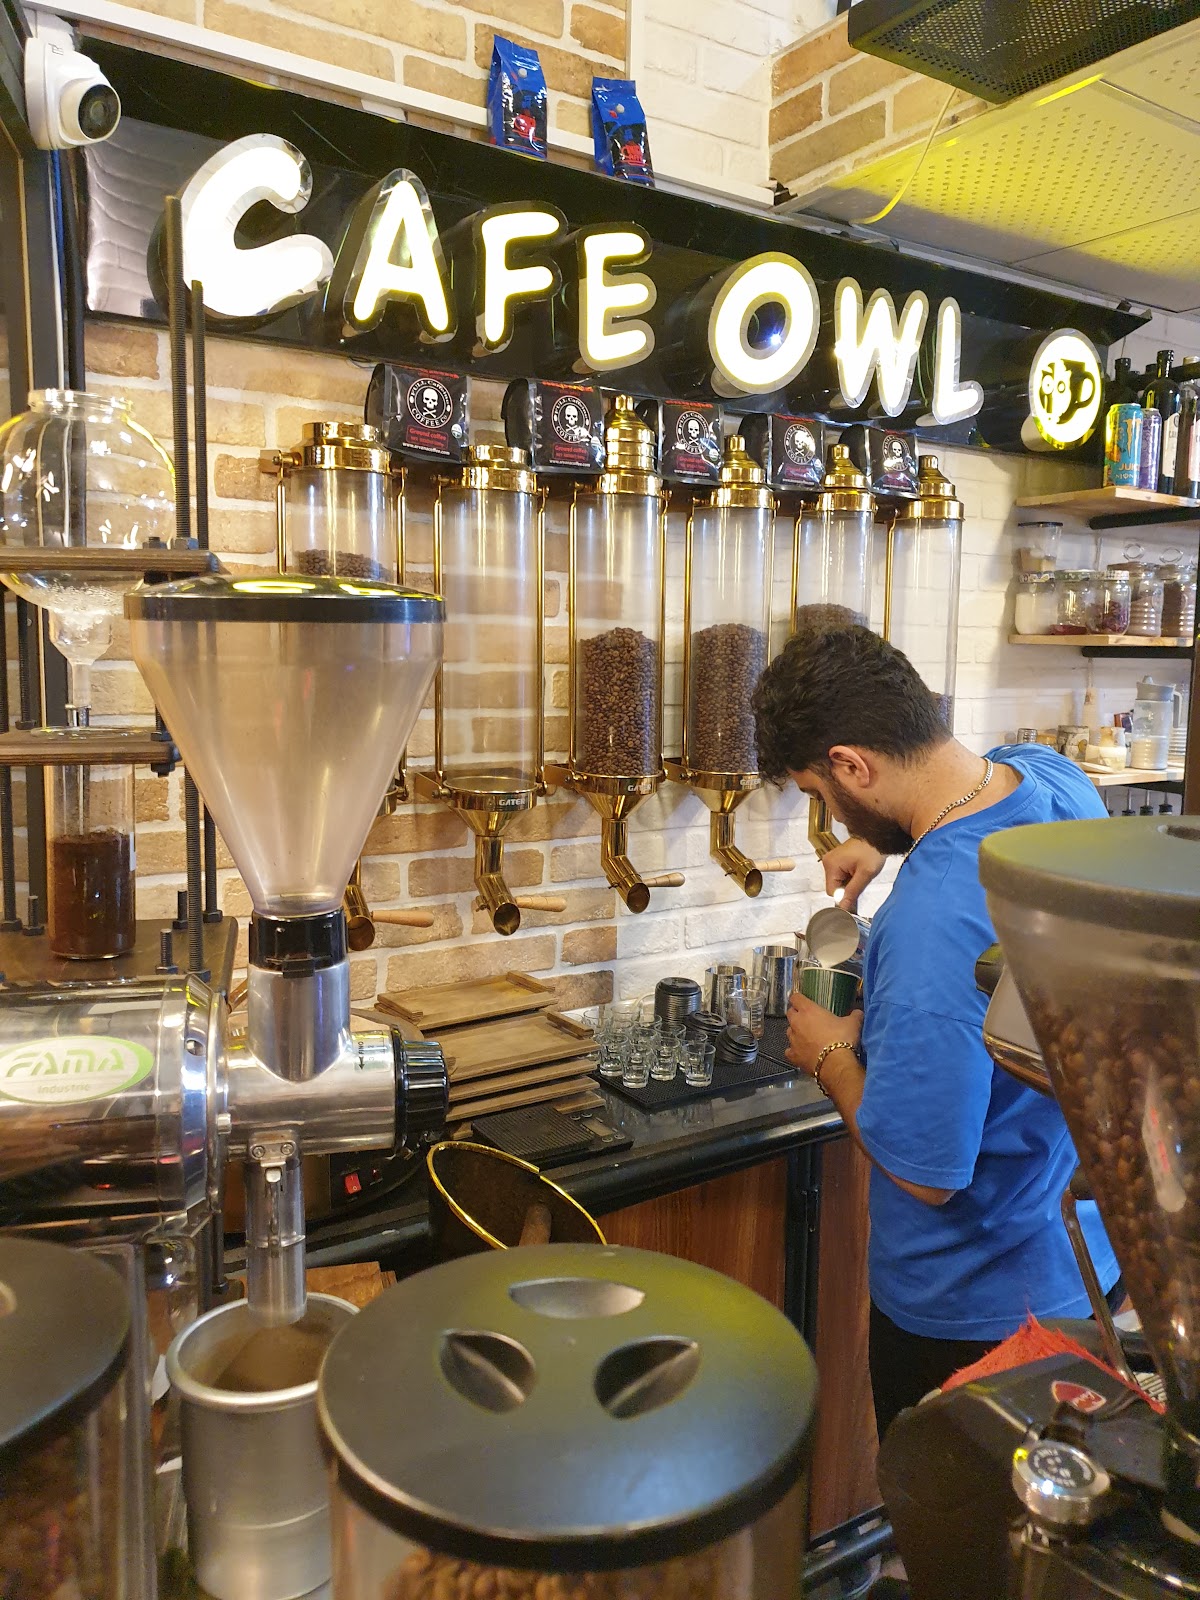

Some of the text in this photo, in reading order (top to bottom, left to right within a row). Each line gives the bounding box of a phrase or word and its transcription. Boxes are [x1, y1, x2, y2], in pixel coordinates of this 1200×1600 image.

[181, 133, 984, 425] CAFE OWL
[411, 407, 440, 427] COFFEE
